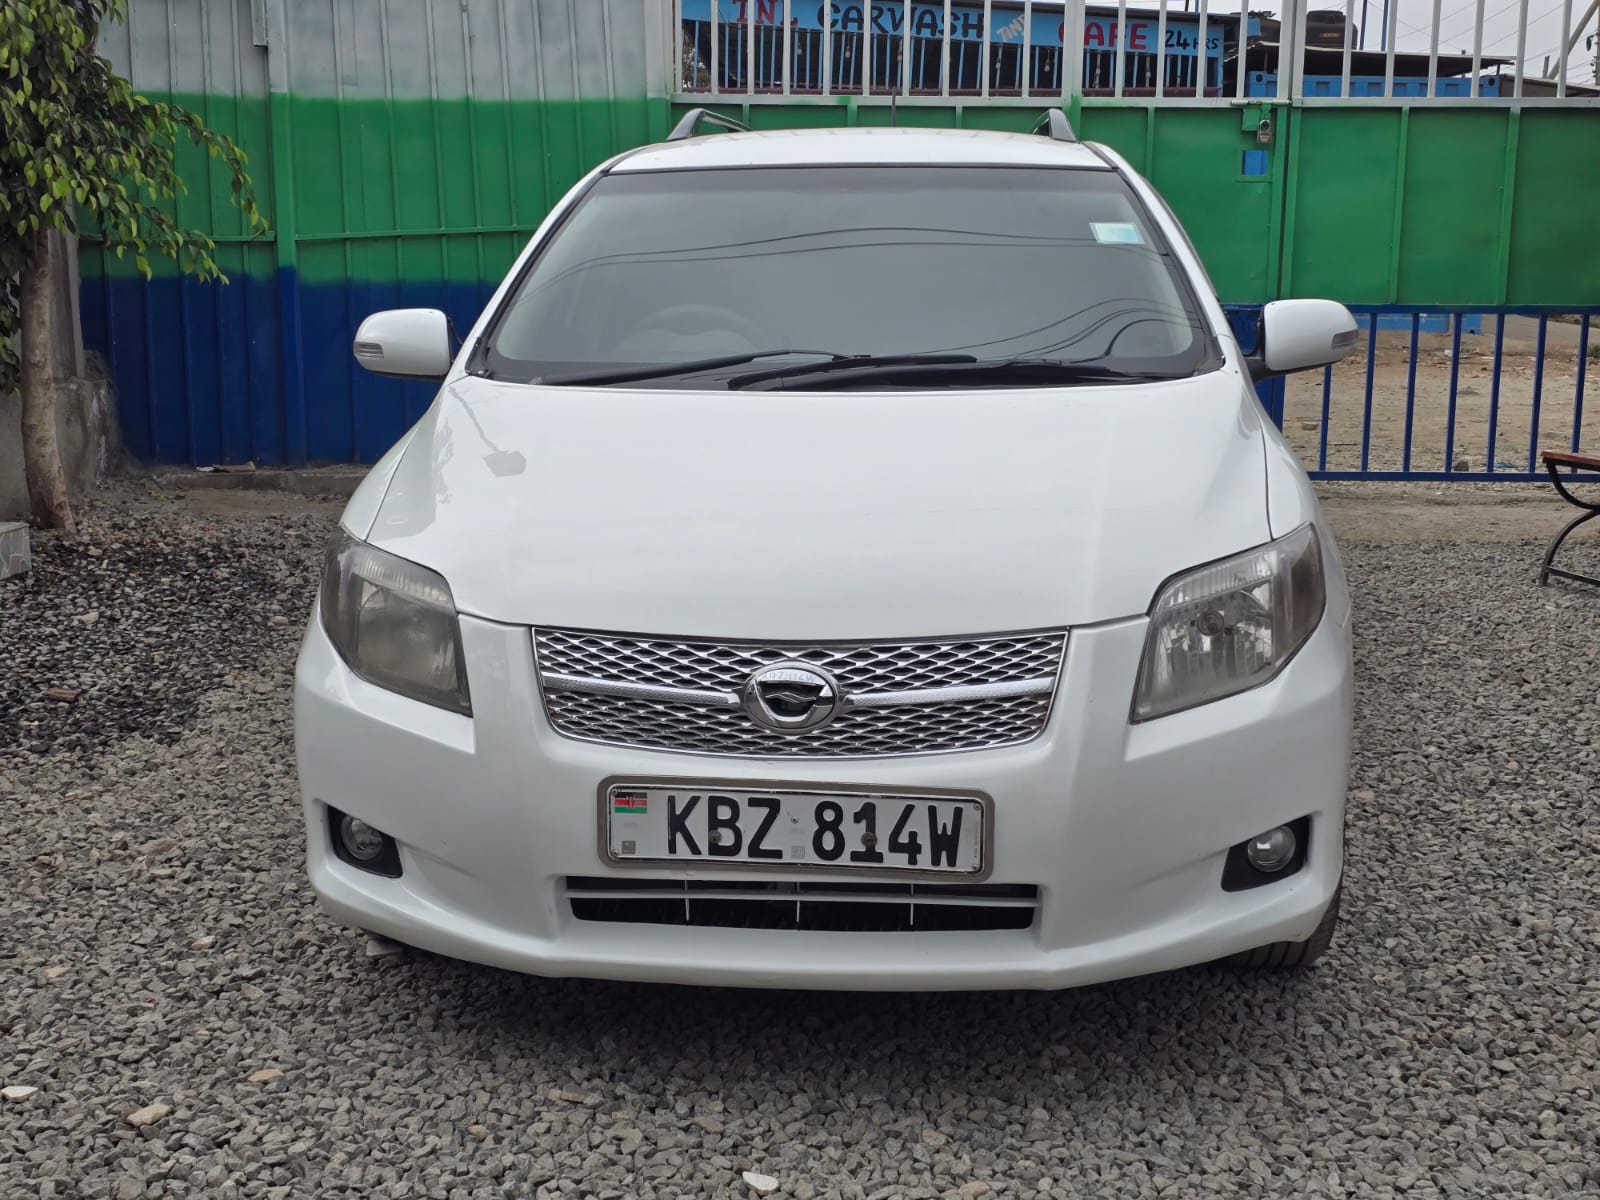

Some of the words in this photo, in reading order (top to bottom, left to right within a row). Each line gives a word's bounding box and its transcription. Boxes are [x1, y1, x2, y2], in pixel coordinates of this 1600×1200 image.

[816, 2, 985, 39] CARWASH
[1164, 30, 1190, 50] 24
[667, 795, 783, 859] KBZ
[811, 801, 964, 868] 814W
